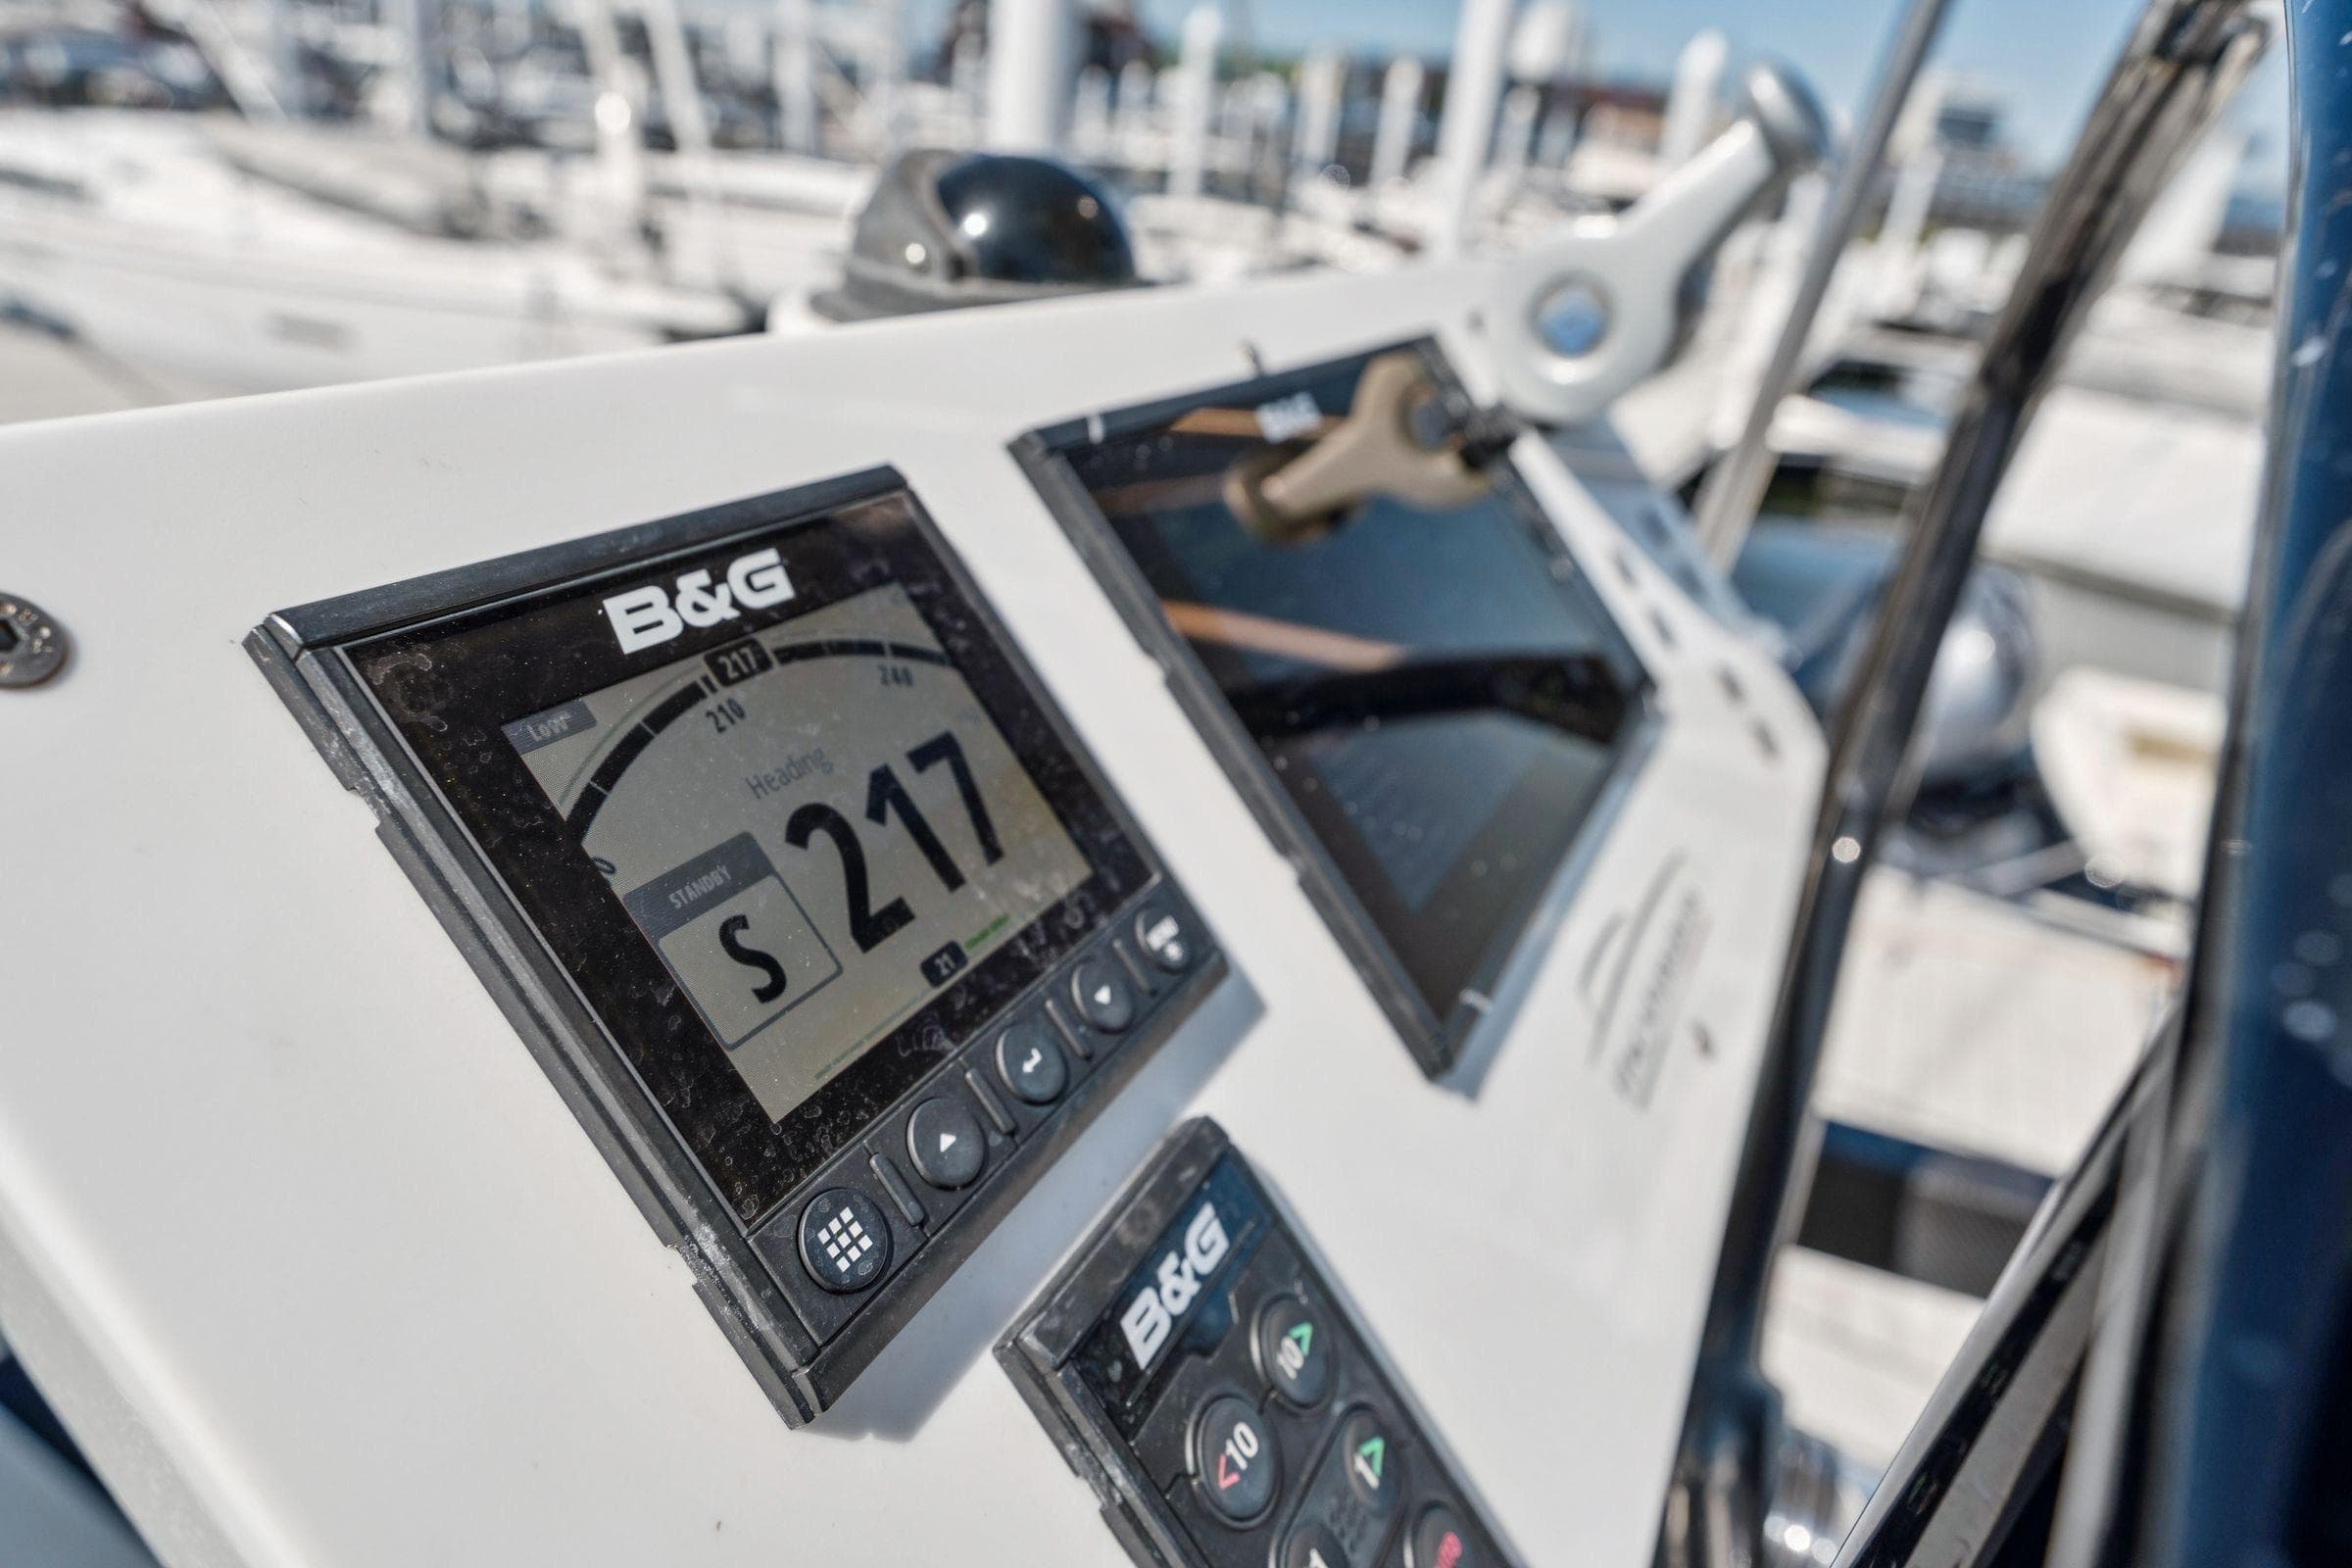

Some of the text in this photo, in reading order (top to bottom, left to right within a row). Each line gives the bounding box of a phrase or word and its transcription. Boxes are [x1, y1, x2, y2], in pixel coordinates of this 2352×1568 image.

[603, 547, 796, 656] B&G
[718, 646, 759, 679] 217
[706, 697, 746, 733] 210
[745, 747, 834, 800] Heading
[785, 730, 1004, 955] 217
[668, 863, 731, 909] STANDBY
[718, 913, 788, 1004] S
[1119, 1200, 1230, 1371] B&G
[1225, 1421, 1258, 1471] 10
